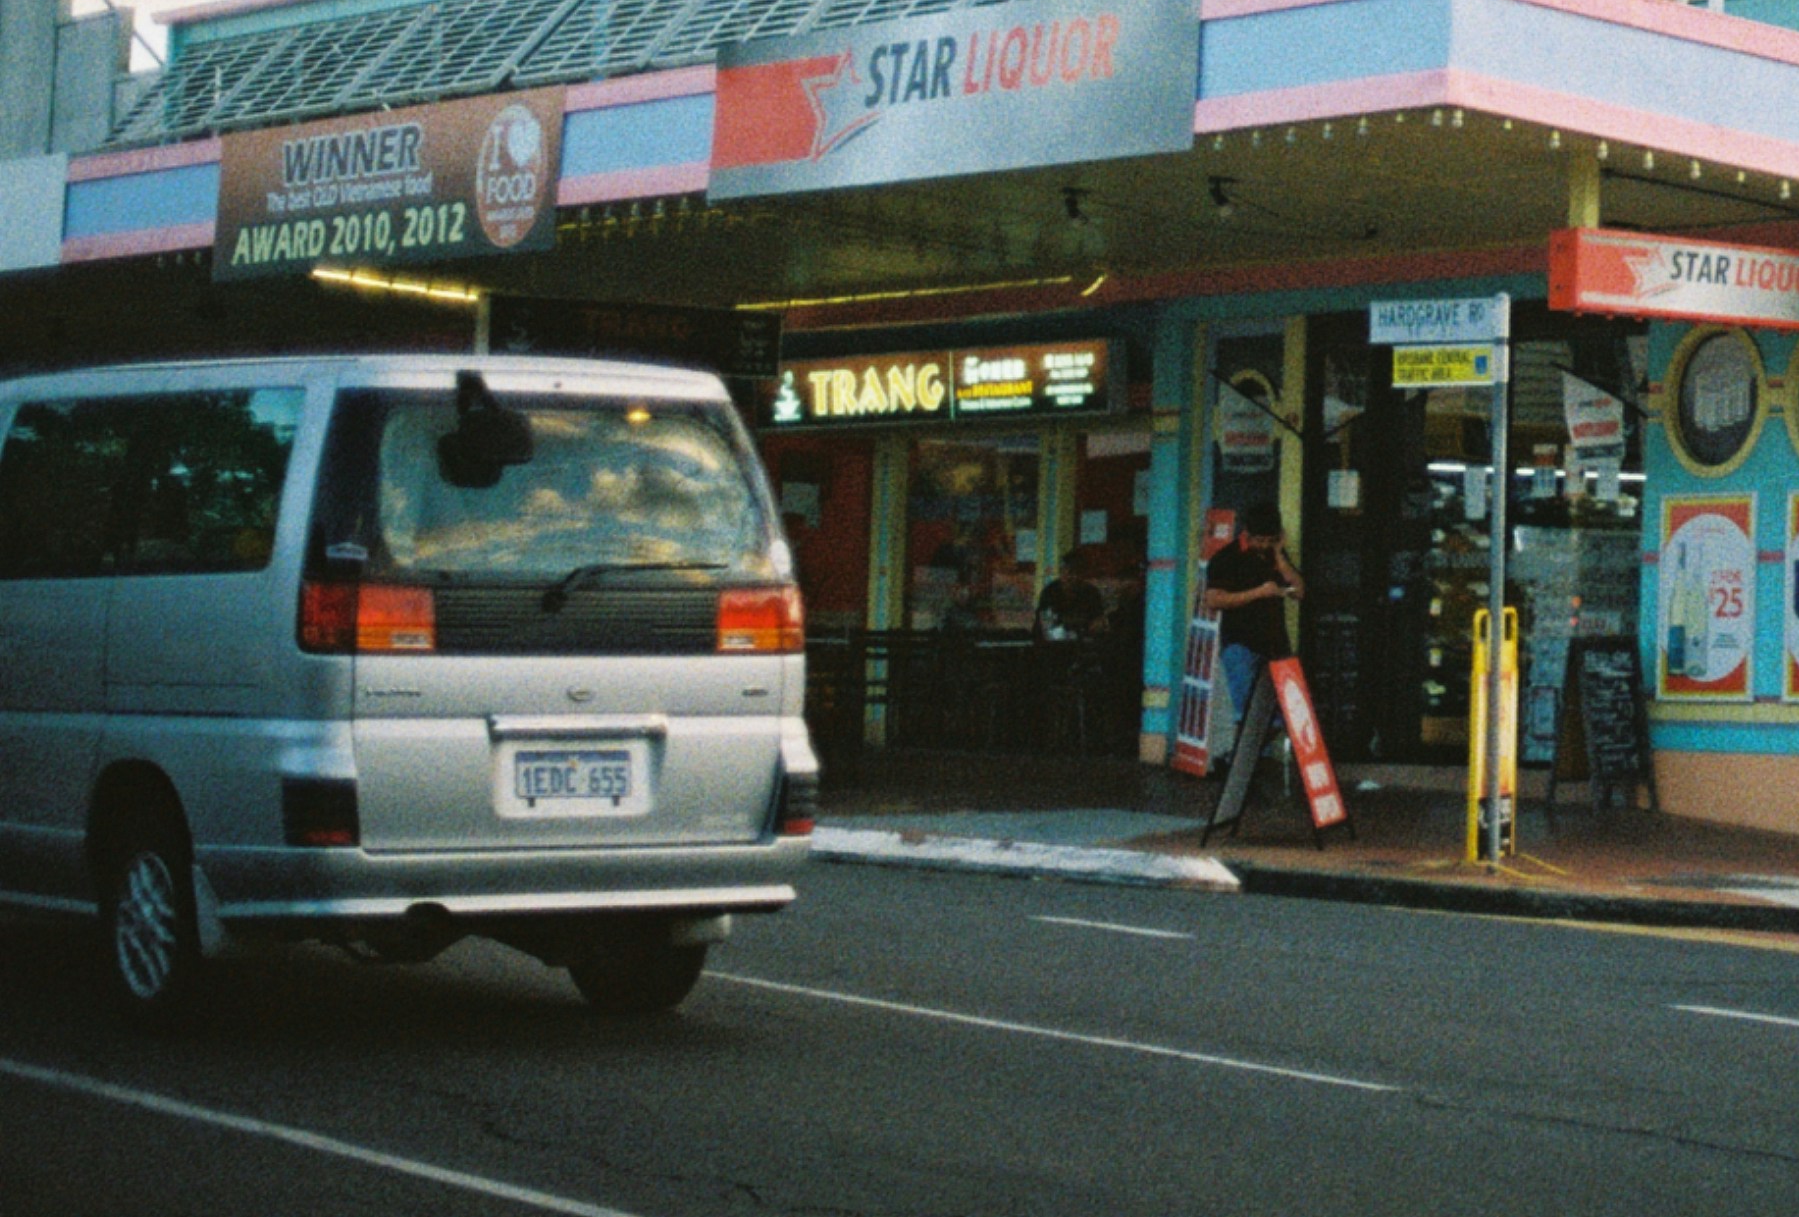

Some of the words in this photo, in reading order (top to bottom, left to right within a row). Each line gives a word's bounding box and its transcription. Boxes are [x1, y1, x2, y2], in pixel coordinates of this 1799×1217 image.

[864, 36, 957, 109] STAR
[962, 13, 1121, 95] LIQUOR
[282, 121, 424, 187] WINNER
[486, 172, 536, 204] FOOD
[231, 218, 326, 266] AWARD
[329, 211, 395, 256] 2010,
[400, 202, 466, 249] 2012
[1670, 250, 1731, 285] STAR
[807, 363, 945, 417] TRANG
[523, 766, 577, 794] 1EDC
[588, 766, 627, 794] 655
